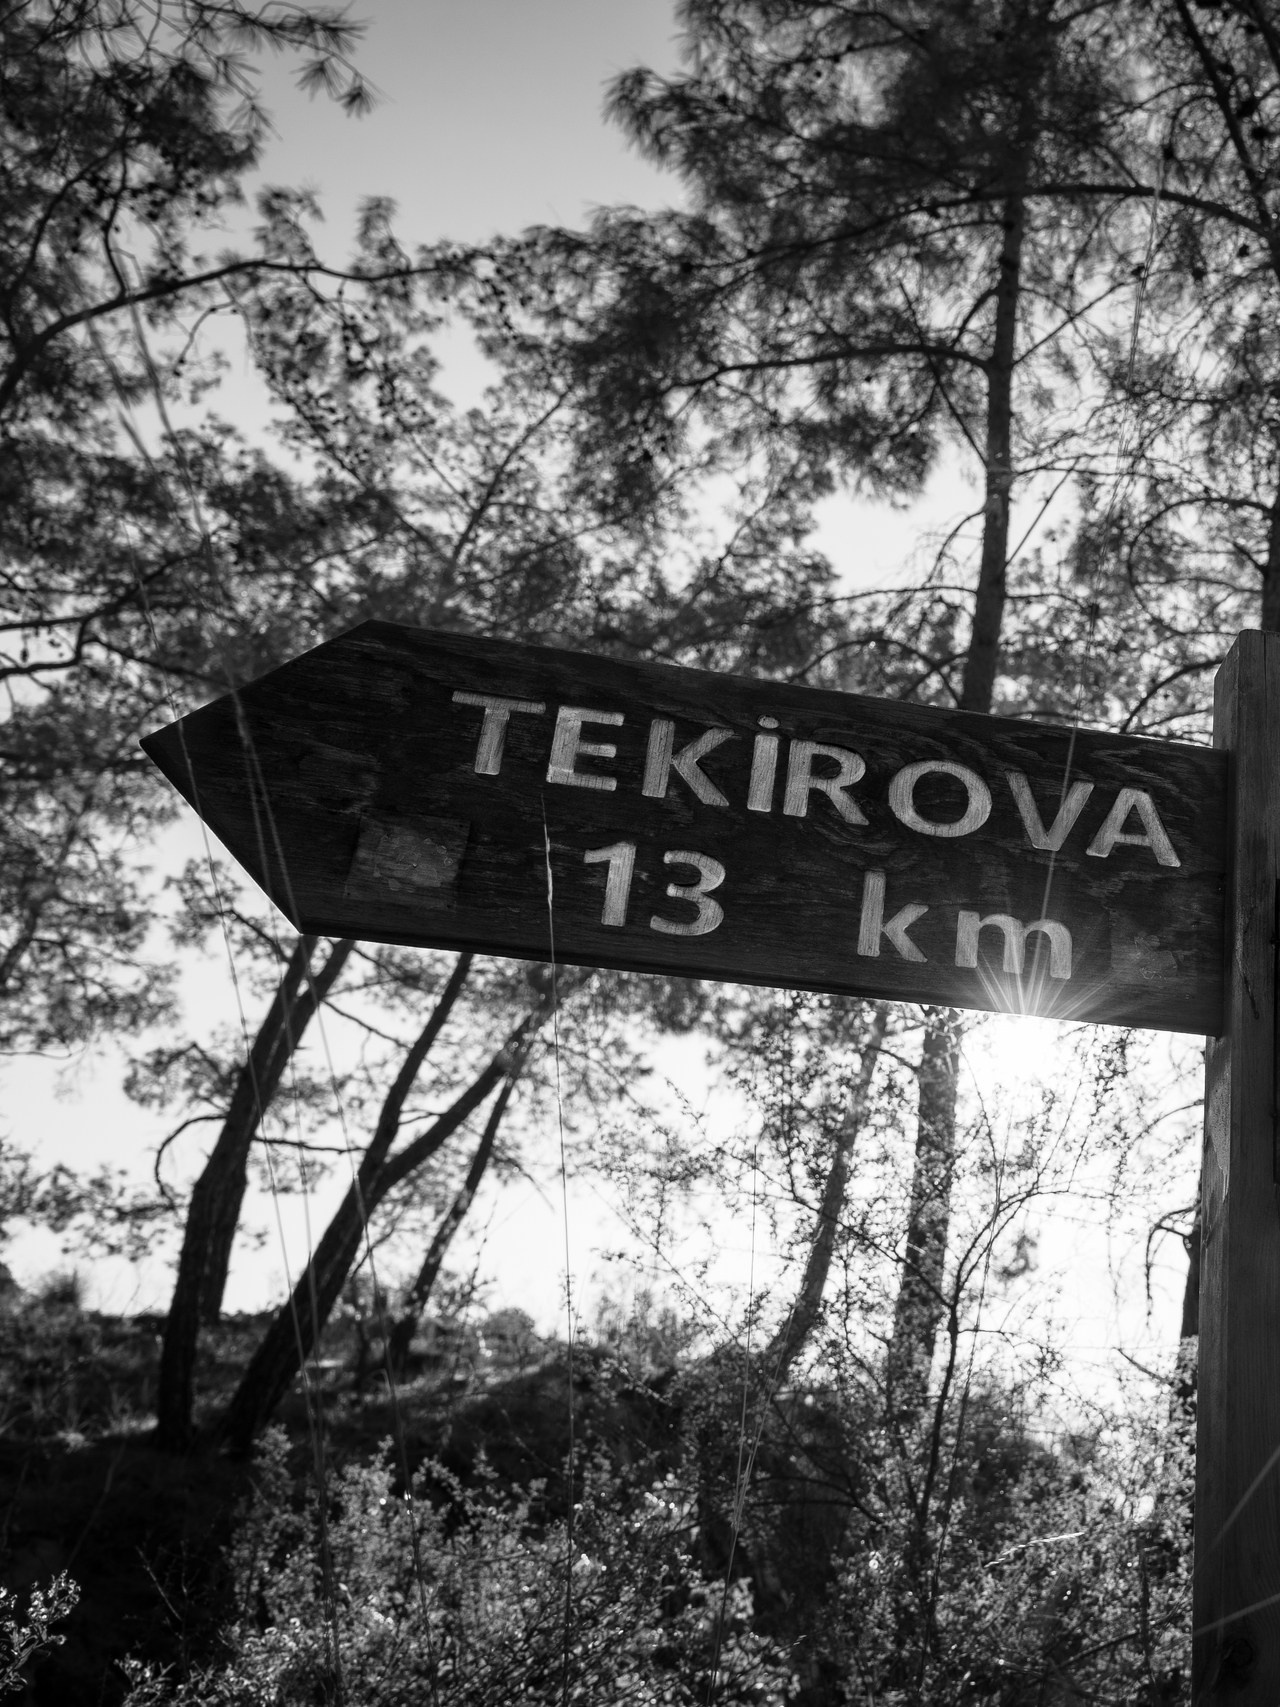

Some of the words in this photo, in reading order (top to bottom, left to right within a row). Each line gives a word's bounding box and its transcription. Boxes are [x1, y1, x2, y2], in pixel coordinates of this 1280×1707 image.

[451, 690, 1182, 869] TEKİROVA
[582, 841, 726, 937] 13
[856, 869, 1074, 980] km
